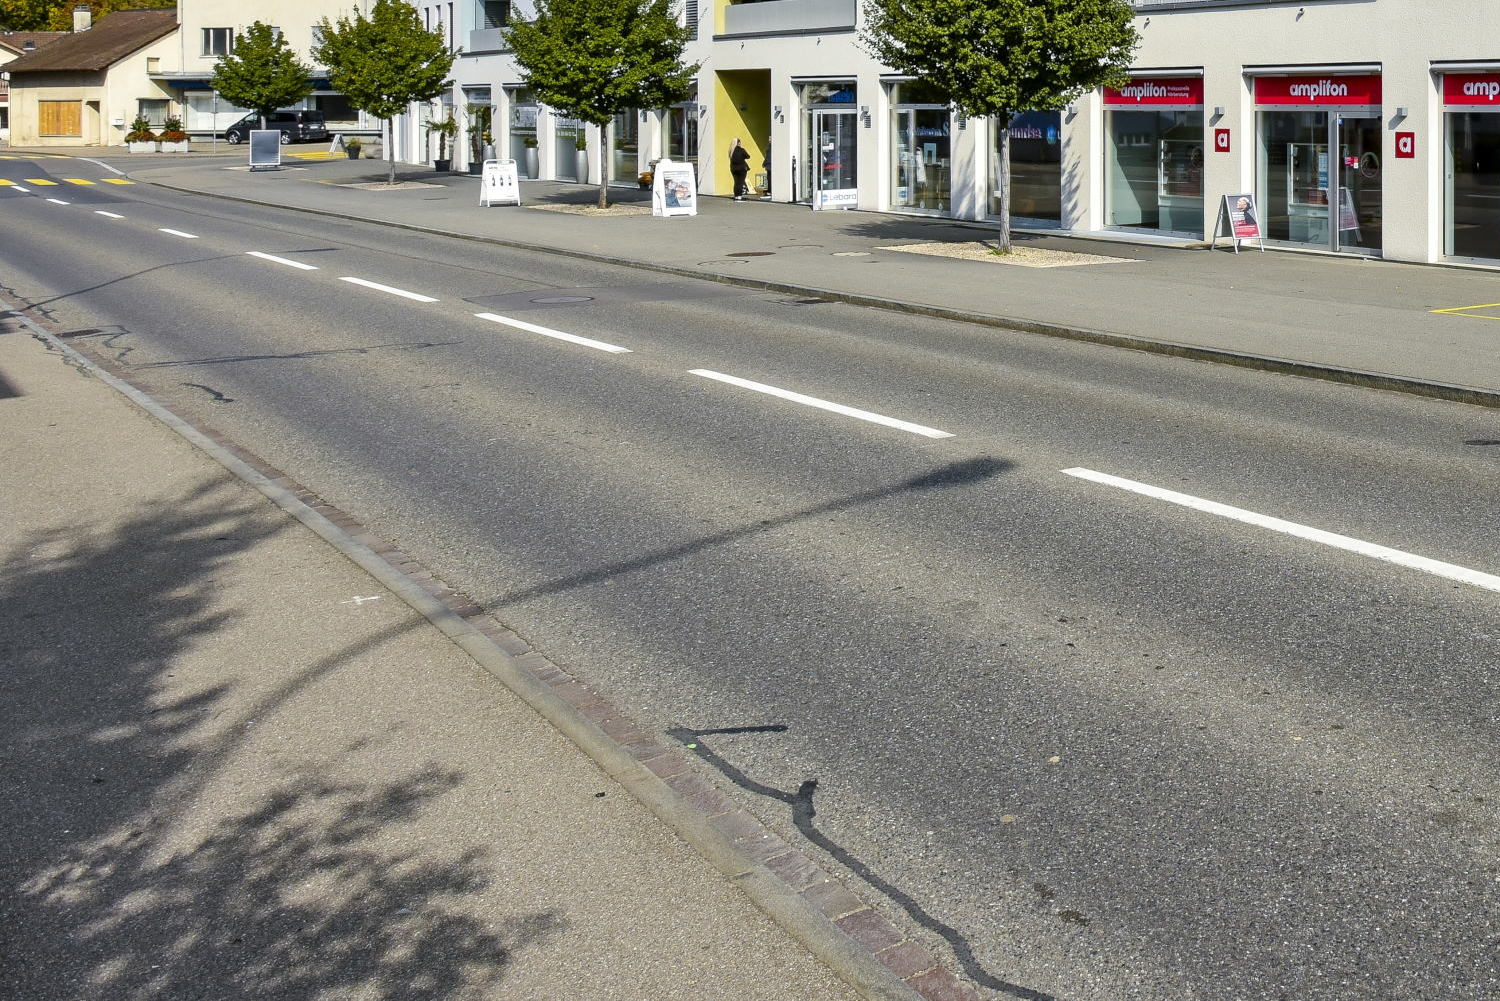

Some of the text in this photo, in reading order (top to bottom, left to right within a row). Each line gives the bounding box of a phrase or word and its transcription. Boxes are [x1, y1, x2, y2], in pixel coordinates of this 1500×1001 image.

[1120, 82, 1167, 102] amplifon
[1290, 79, 1348, 101] amplifon
[829, 193, 857, 201] Lebara
